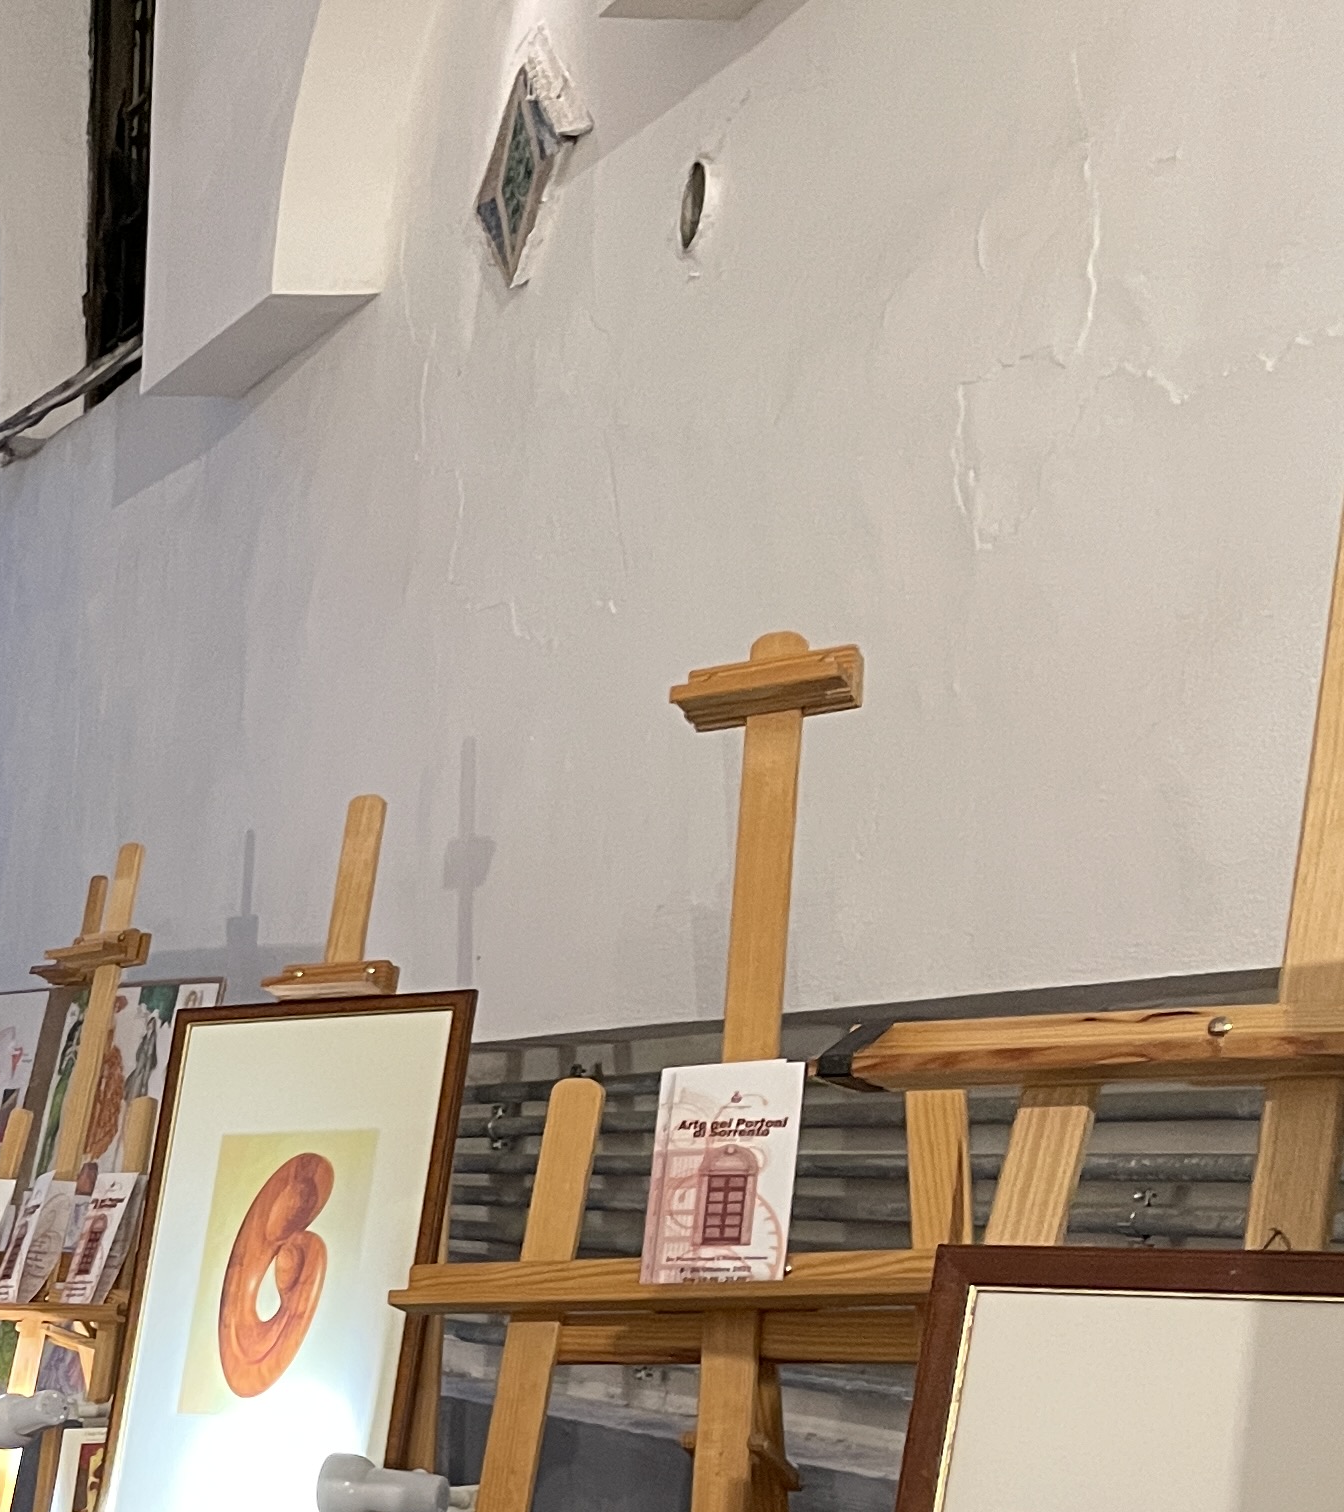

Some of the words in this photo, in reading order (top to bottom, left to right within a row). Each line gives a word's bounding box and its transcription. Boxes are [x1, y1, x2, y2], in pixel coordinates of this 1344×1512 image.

[678, 1119, 707, 1131] Arte
[735, 1115, 789, 1129] Portoni
[693, 1128, 706, 1138] di
[709, 1127, 771, 1138] Sorrento
